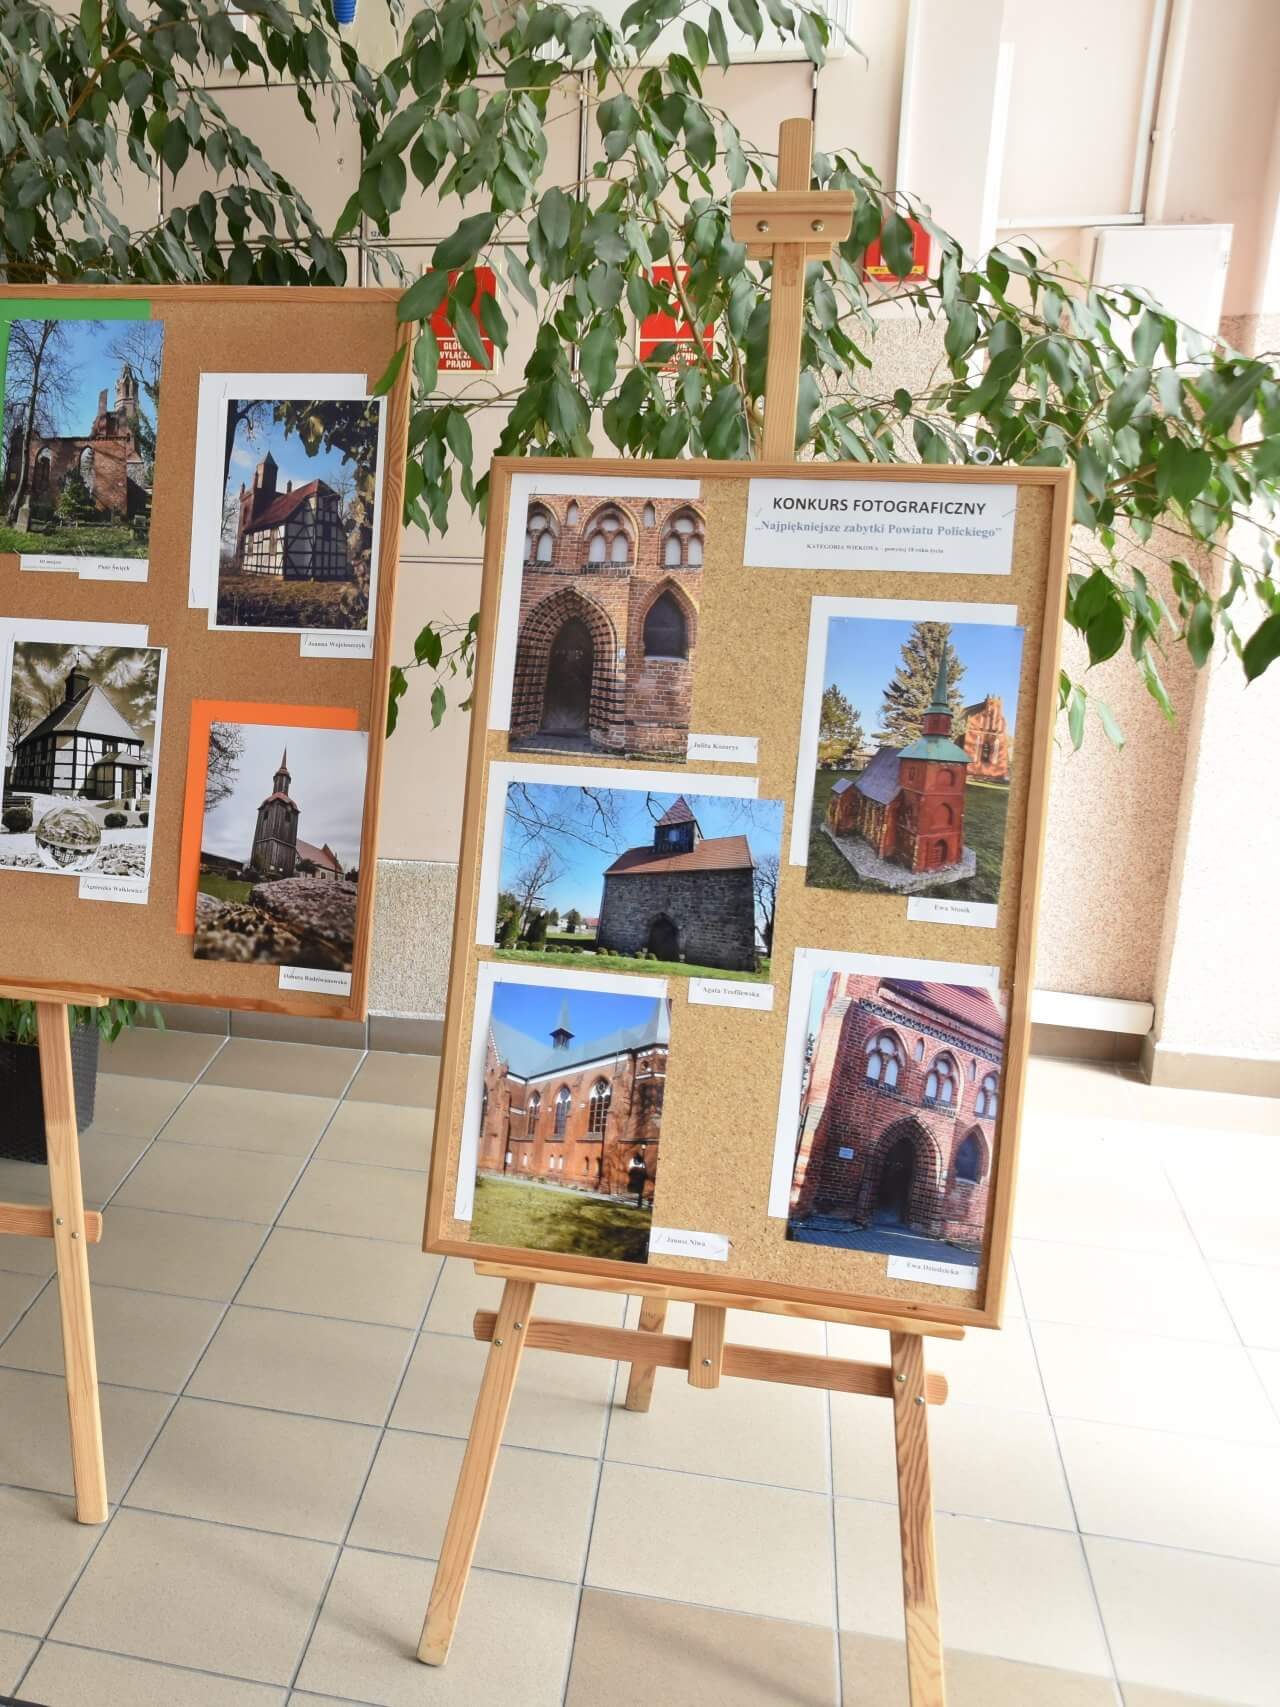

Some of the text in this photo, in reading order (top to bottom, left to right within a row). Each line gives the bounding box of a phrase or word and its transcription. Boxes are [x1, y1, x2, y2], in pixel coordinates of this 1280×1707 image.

[773, 497, 986, 515] KONKURS FOTOGRAFICZNY
[843, 522, 885, 535] zabytki
[888, 524, 934, 536] Powiatu
